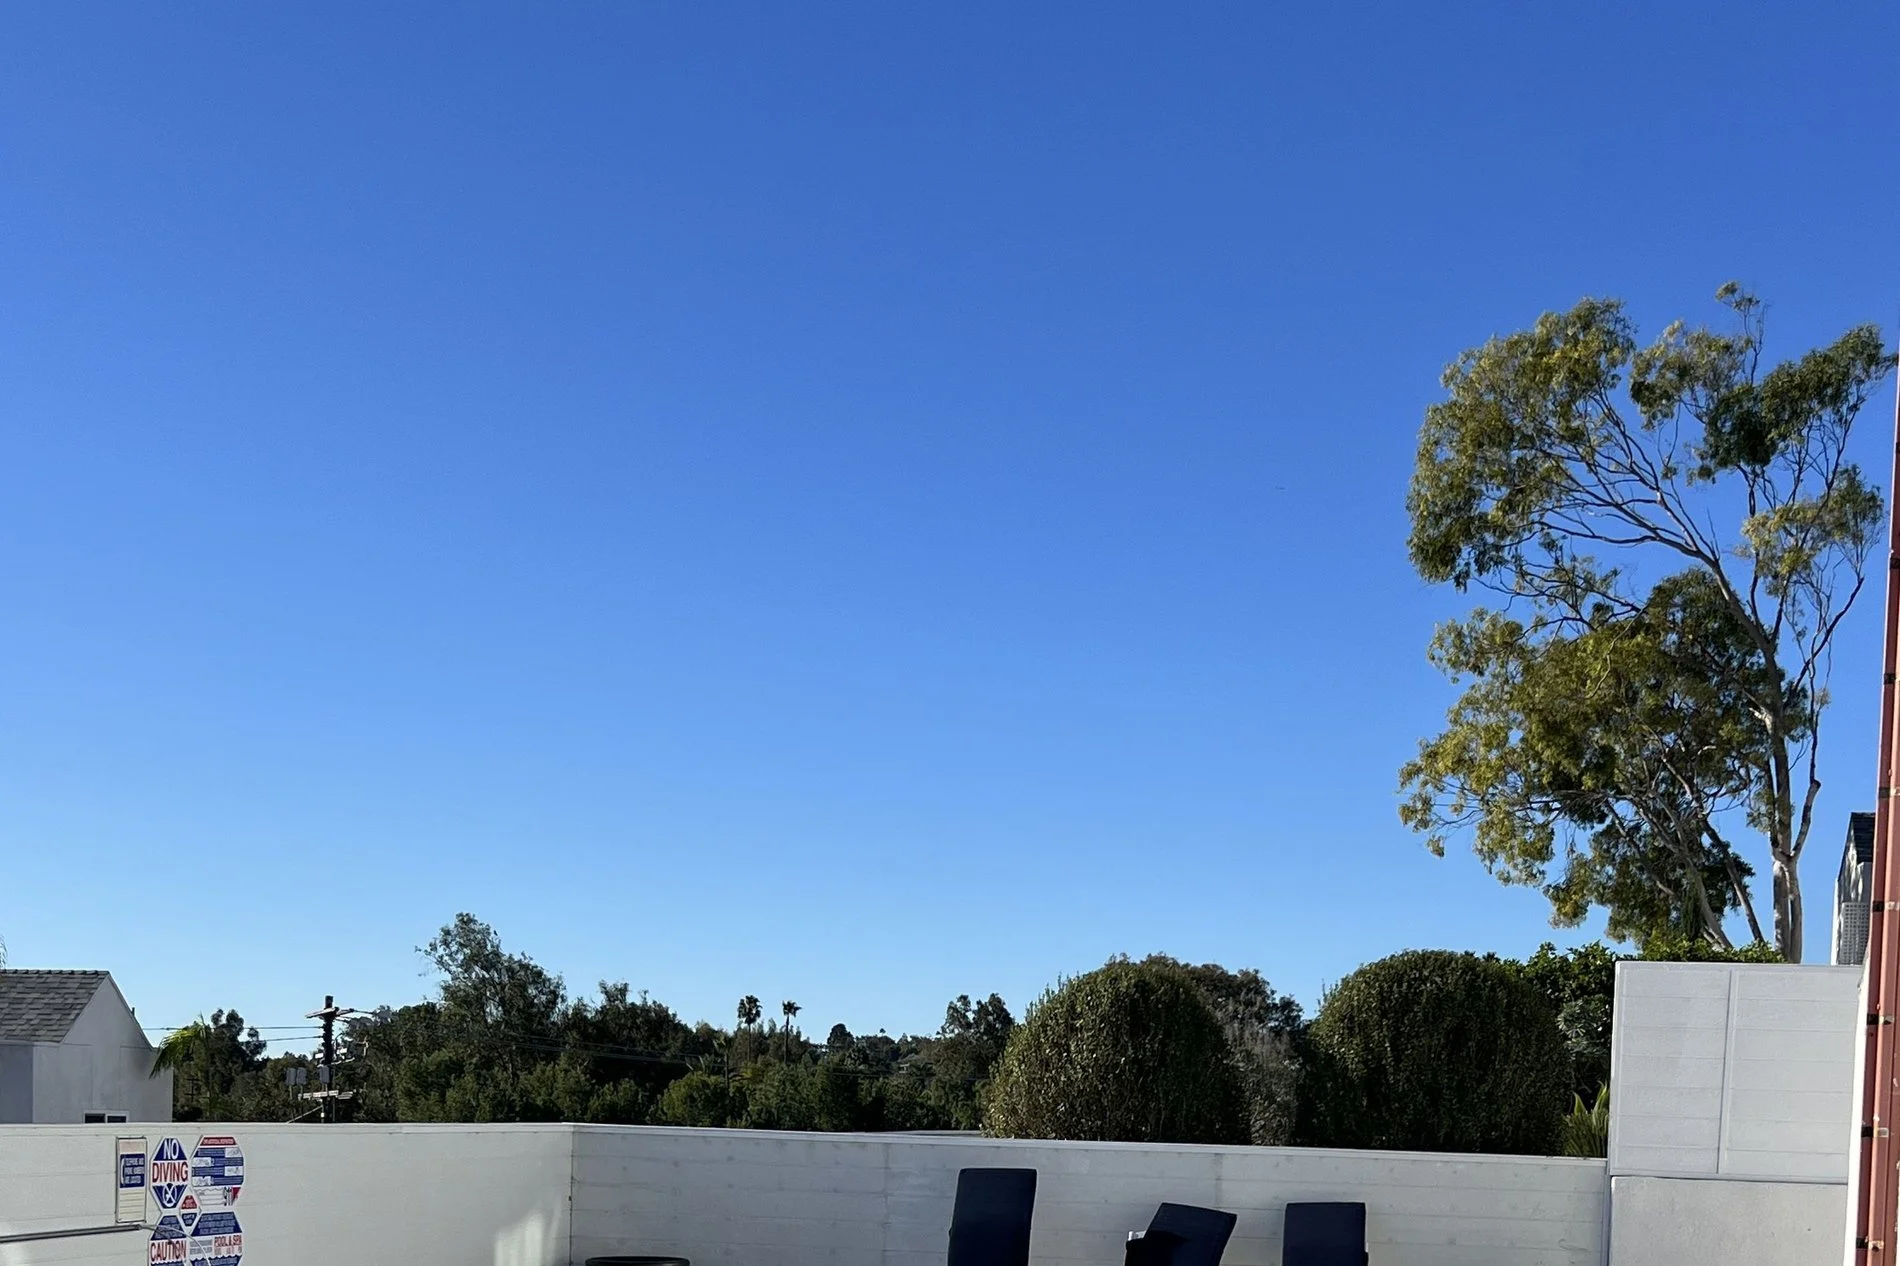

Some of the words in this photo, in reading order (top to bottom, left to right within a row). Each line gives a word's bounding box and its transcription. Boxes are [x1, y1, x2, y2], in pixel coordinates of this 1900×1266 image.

[163, 1139, 179, 1160] NO
[152, 1161, 189, 1182] DIVING
[150, 1240, 187, 1261] CAUTION
